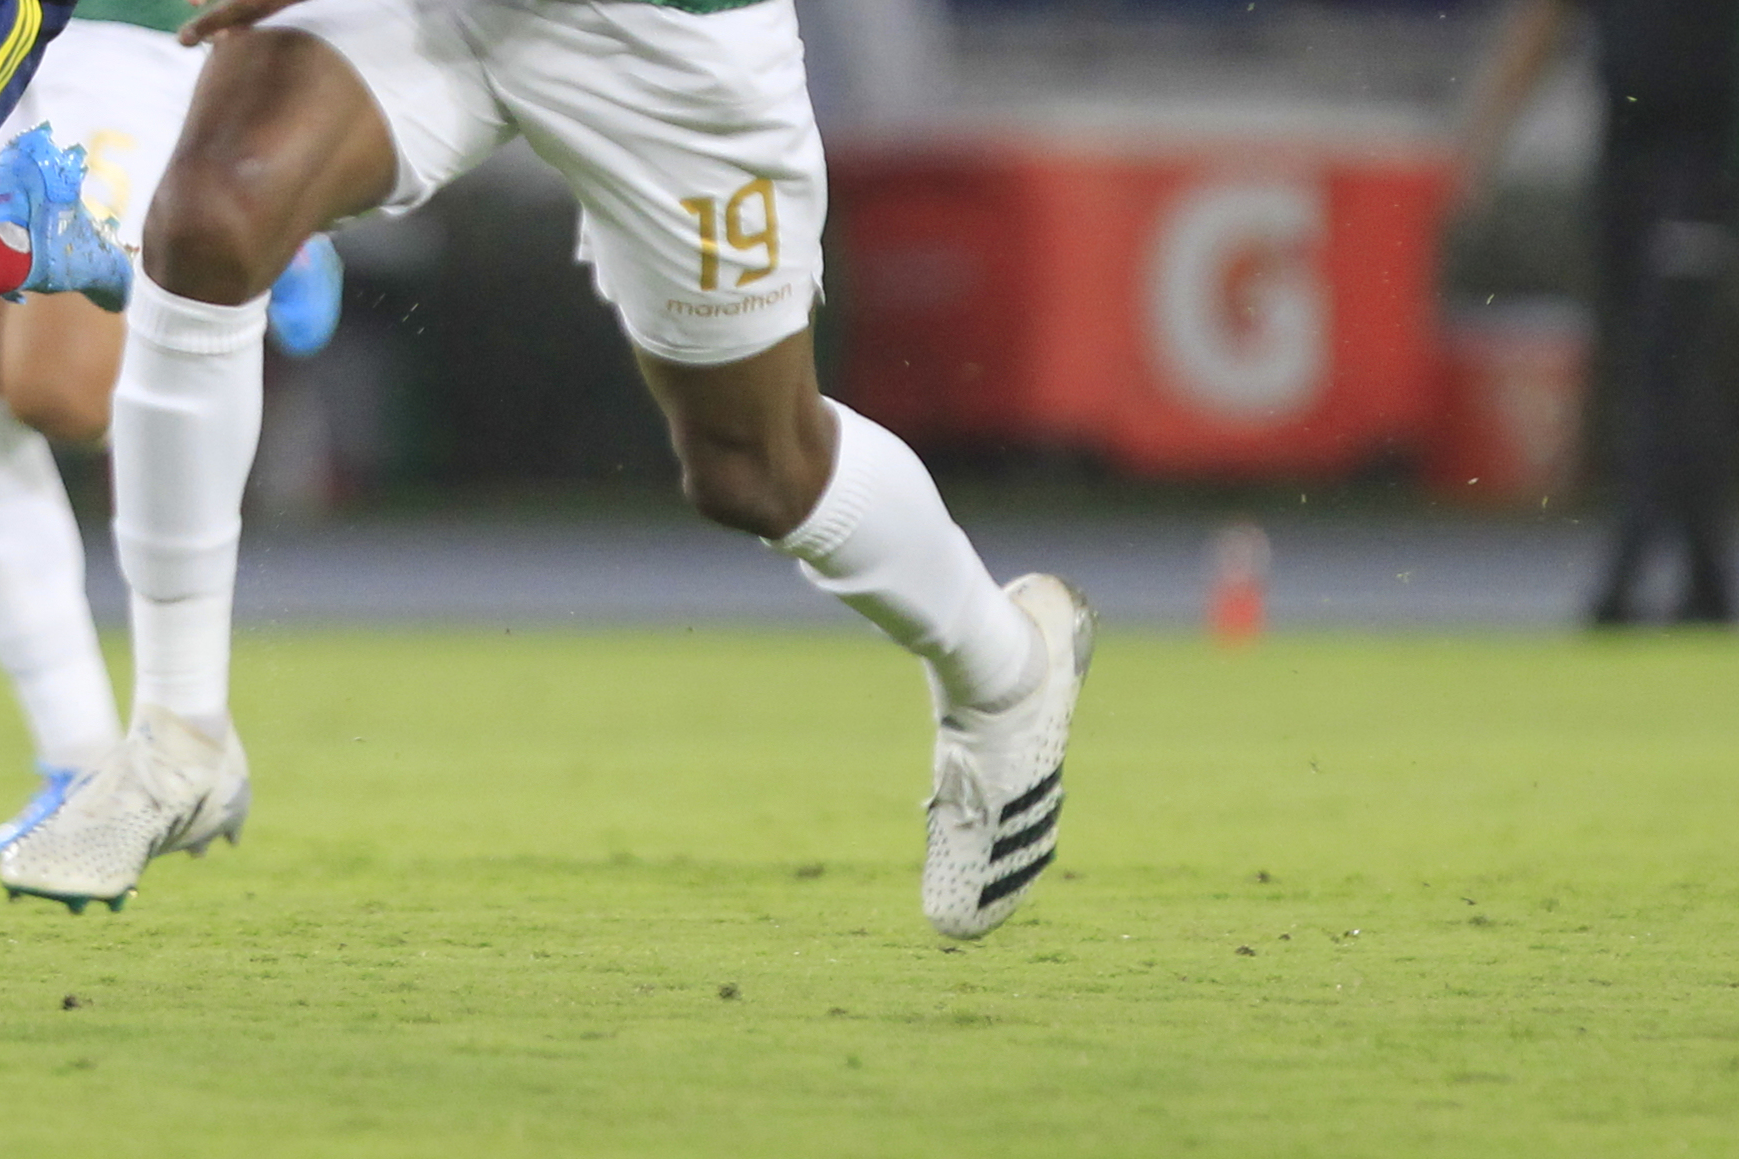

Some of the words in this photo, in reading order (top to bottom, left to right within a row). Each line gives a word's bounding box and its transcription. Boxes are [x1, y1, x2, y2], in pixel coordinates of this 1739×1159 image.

[681, 178, 780, 291] 19
[667, 283, 792, 317] marathon
[1148, 185, 1330, 415] G
